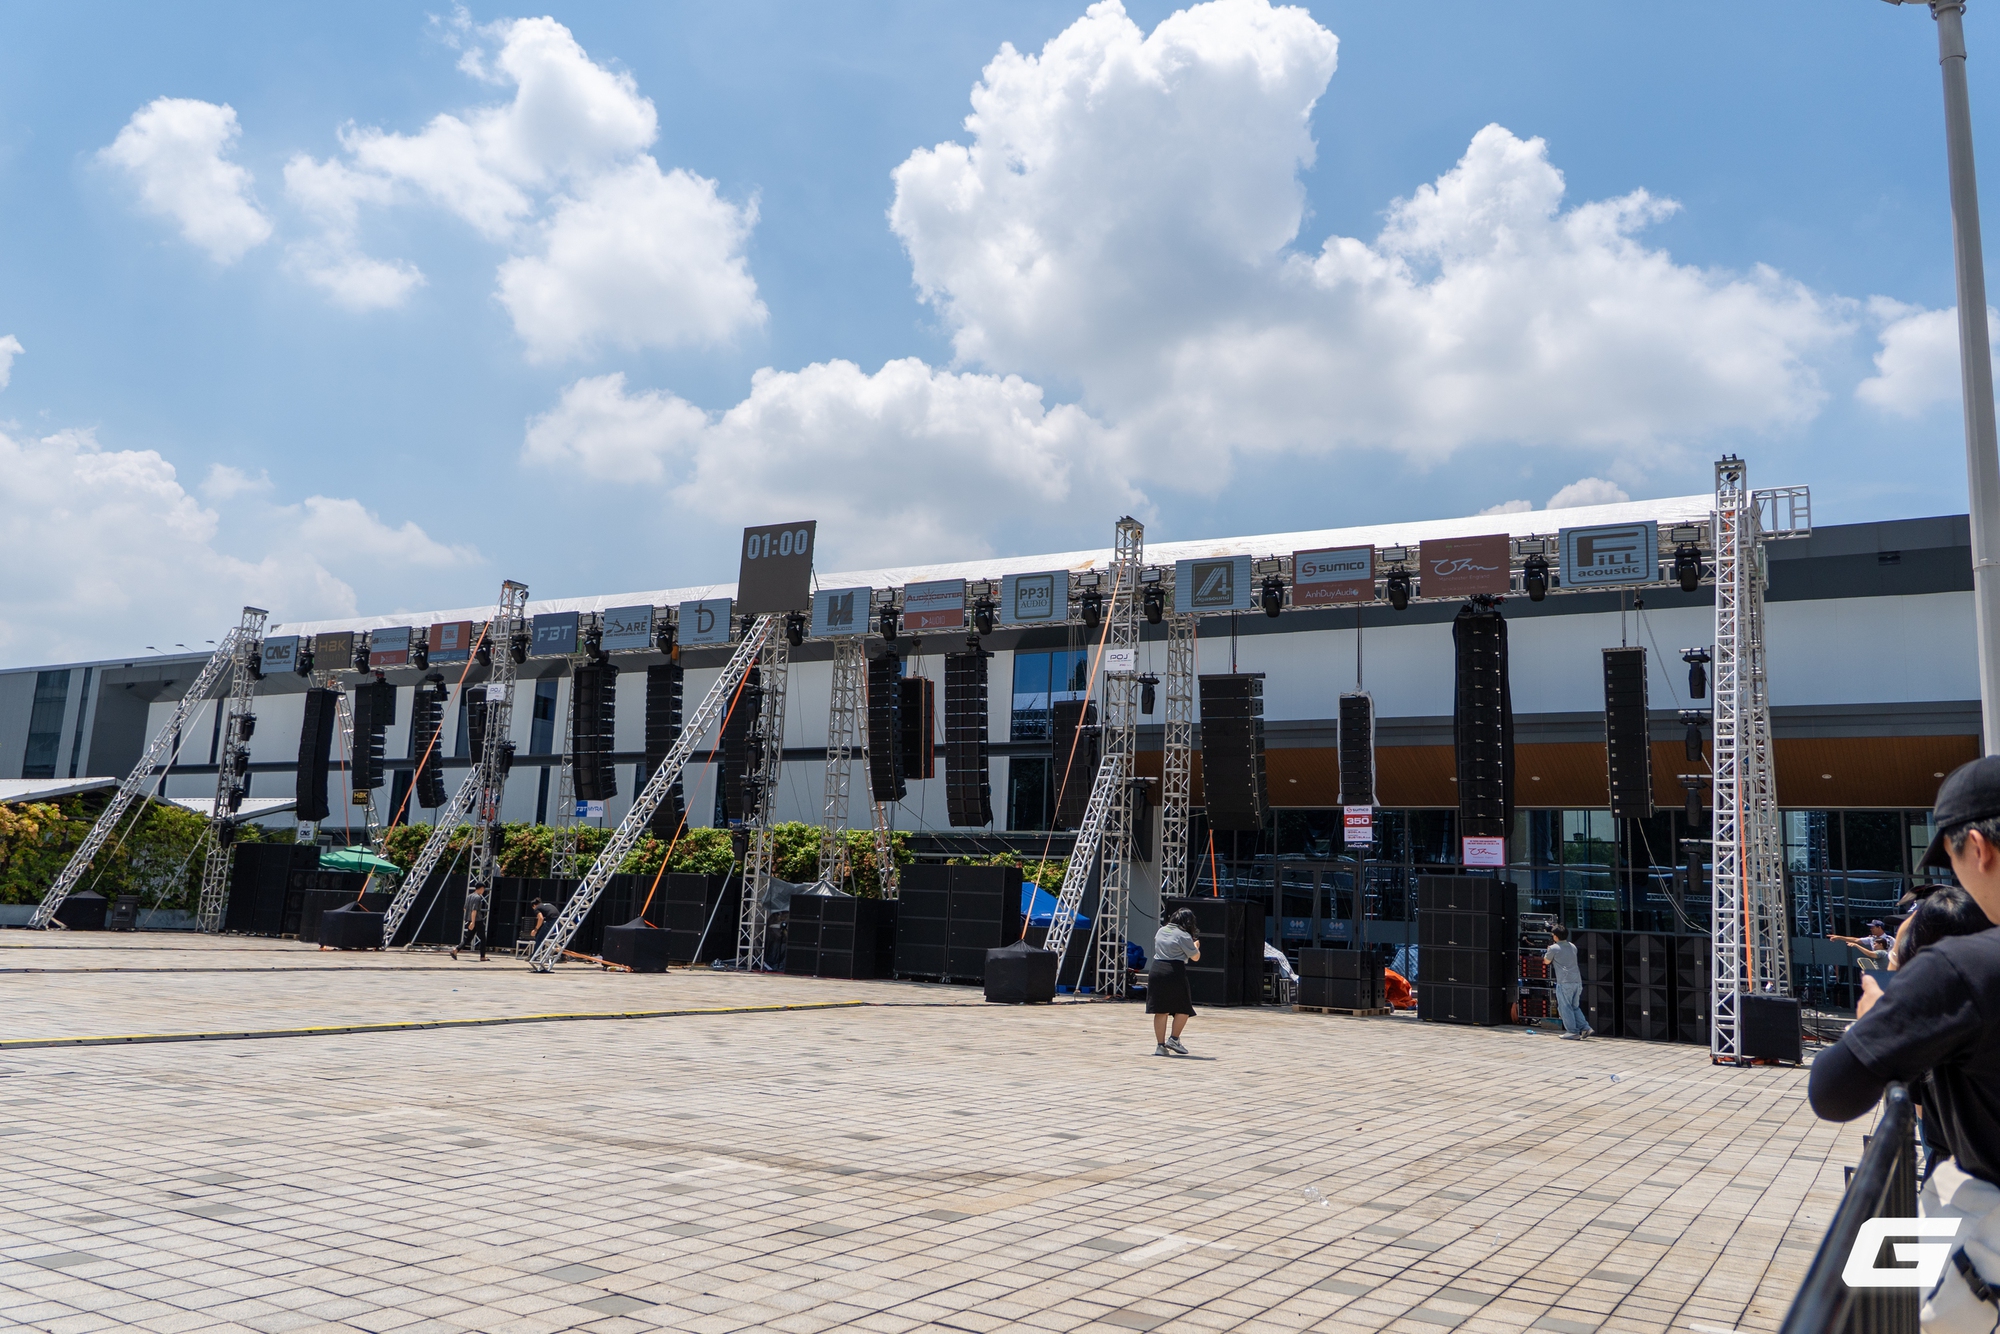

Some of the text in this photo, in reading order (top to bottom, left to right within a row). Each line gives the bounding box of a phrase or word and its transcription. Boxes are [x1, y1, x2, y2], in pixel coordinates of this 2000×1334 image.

[747, 529, 808, 559] 01:00
[1578, 566, 1639, 577] acoustic
[1019, 587, 1049, 600] PP31
[1020, 600, 1047, 608] AUDIO
[537, 625, 572, 642] FBT
[318, 639, 347, 653] HBK
